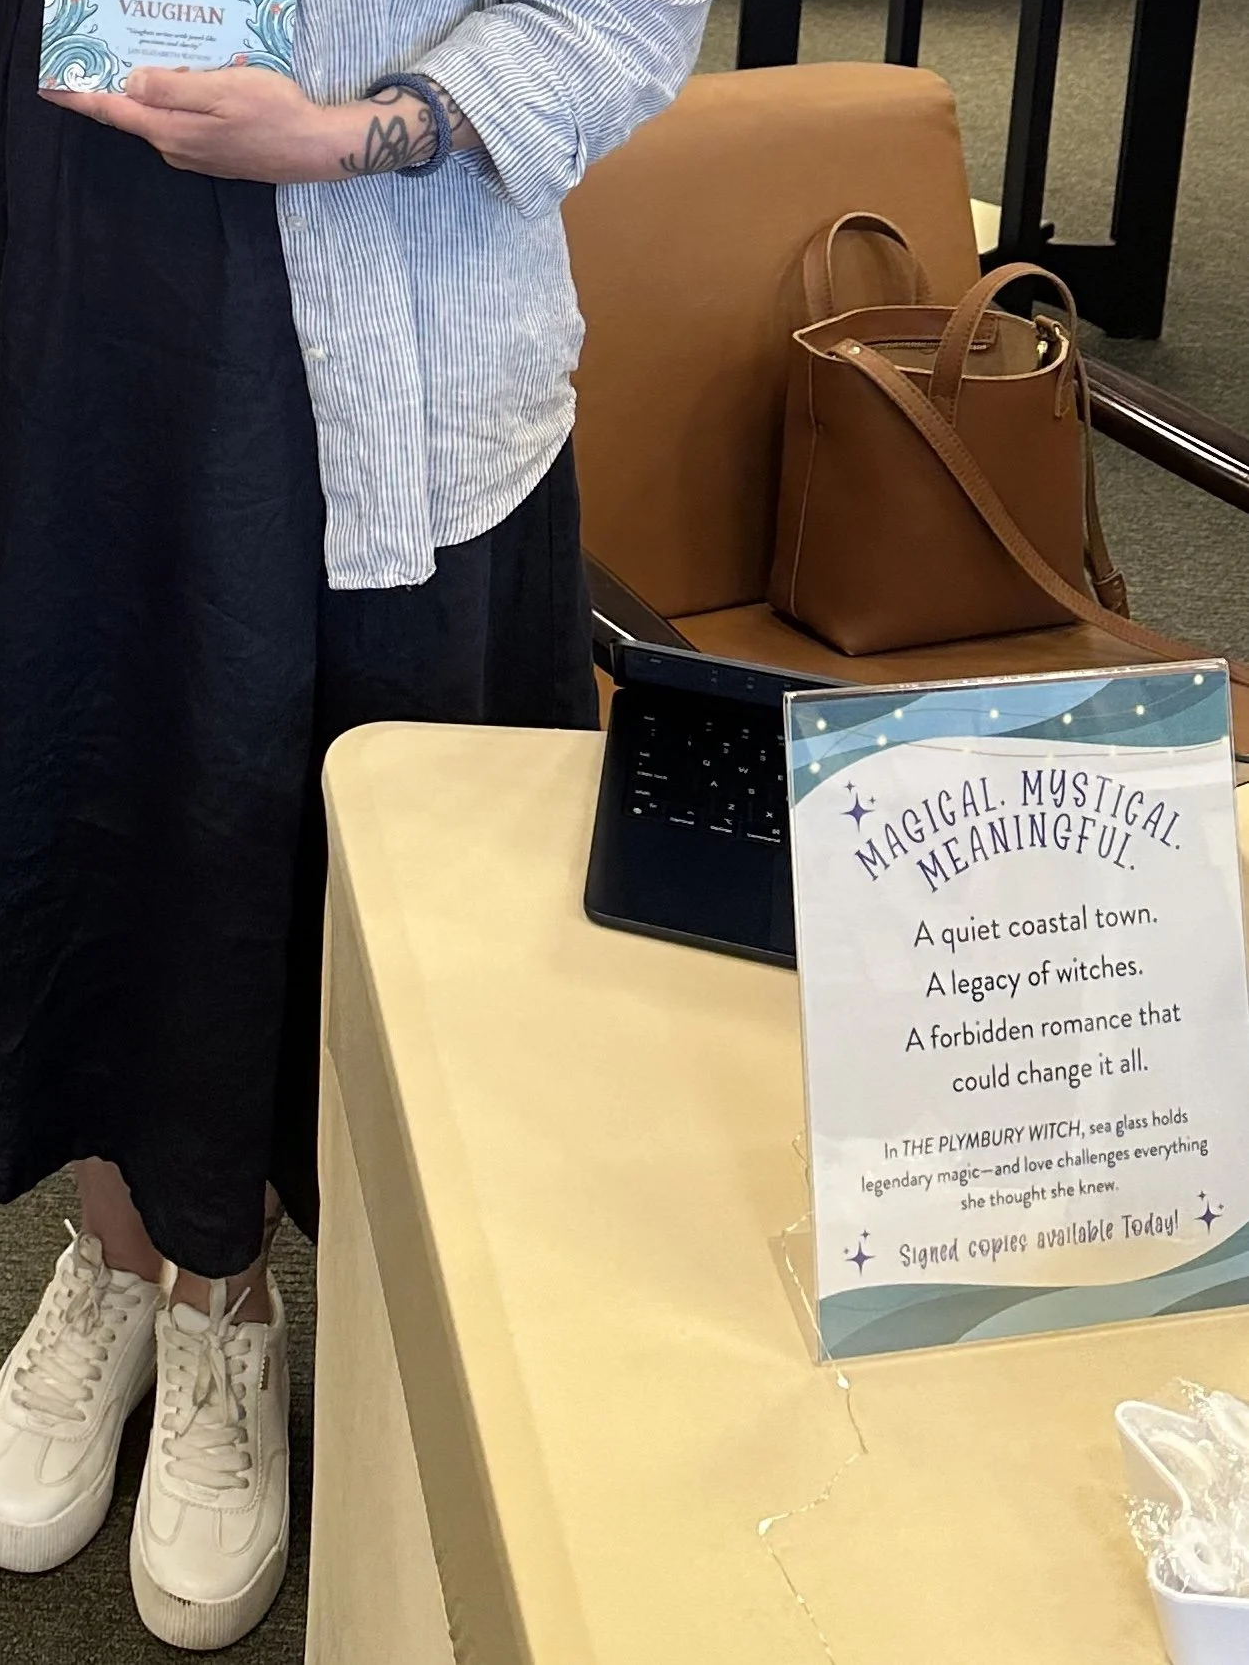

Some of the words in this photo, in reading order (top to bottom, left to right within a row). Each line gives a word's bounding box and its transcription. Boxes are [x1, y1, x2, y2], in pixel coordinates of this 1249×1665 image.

[854, 775, 1007, 882] MAGICAL.
[1020, 768, 1183, 851] MYSTICAL.
[915, 810, 1137, 894] MEANINGFUL.
[913, 919, 935, 948] A
[941, 914, 1001, 953] quiet
[1008, 903, 1088, 938] coastal
[1094, 904, 1159, 929] town.
[925, 971, 947, 998] A
[951, 968, 1021, 1002] legacy
[1028, 959, 1051, 986] of
[1056, 954, 1144, 984] witches.
[905, 1027, 926, 1052] A
[930, 1016, 1034, 1051] forbidden
[1041, 1011, 1132, 1039] romance
[1139, 1001, 1182, 1028] that
[951, 1062, 1010, 1094] could
[1016, 1057, 1093, 1089] change
[1098, 1051, 1114, 1076] it
[1119, 1047, 1149, 1074] all.
[884, 1141, 899, 1160] In
[901, 1137, 934, 1157] THE
[938, 1125, 1026, 1153] PLYMBURY
[1028, 1118, 1086, 1140] WITCH,
[1089, 1120, 1112, 1134] sea
[1115, 1114, 1148, 1138] glass
[1151, 1108, 1189, 1128] holds
[861, 1172, 933, 1198] legendary
[1023, 1152, 1053, 1172] love
[1057, 1146, 1131, 1171] challenges
[1133, 1136, 1209, 1164] everything
[960, 1192, 986, 1211] she
[989, 1186, 1047, 1209] thought
[1051, 1182, 1075, 1201] she
[1078, 1178, 1120, 1196] knew.
[898, 1238, 959, 1271] Signed
[968, 1231, 1028, 1262] copies
[1037, 1217, 1114, 1250] available
[1122, 1210, 1180, 1241] Today!
